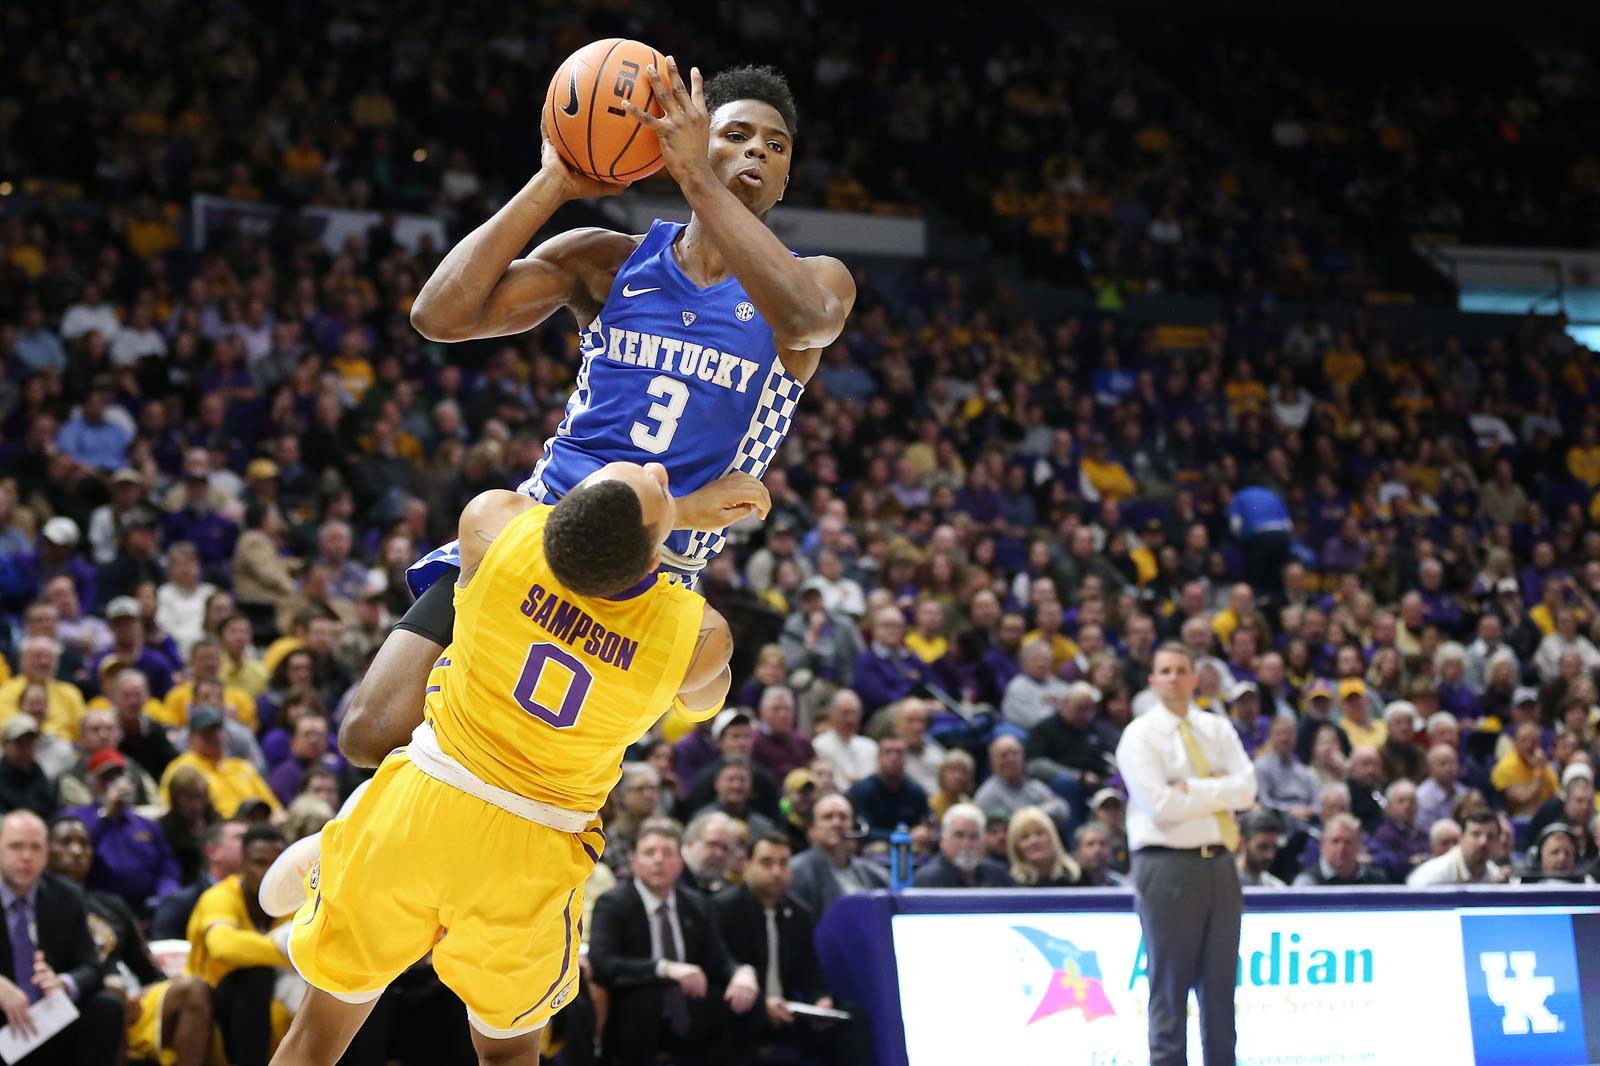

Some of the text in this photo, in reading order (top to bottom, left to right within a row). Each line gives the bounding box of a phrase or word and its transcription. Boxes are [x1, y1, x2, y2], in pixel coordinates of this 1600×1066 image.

[607, 59, 640, 118] LSU
[736, 302, 753, 320] SEC
[607, 327, 760, 394] KENTUCKY
[629, 375, 690, 455] 3
[520, 583, 639, 671] SAMPSON
[513, 641, 594, 729] 0
[1128, 931, 1374, 990] Adian
[1480, 951, 1559, 1035] UK
